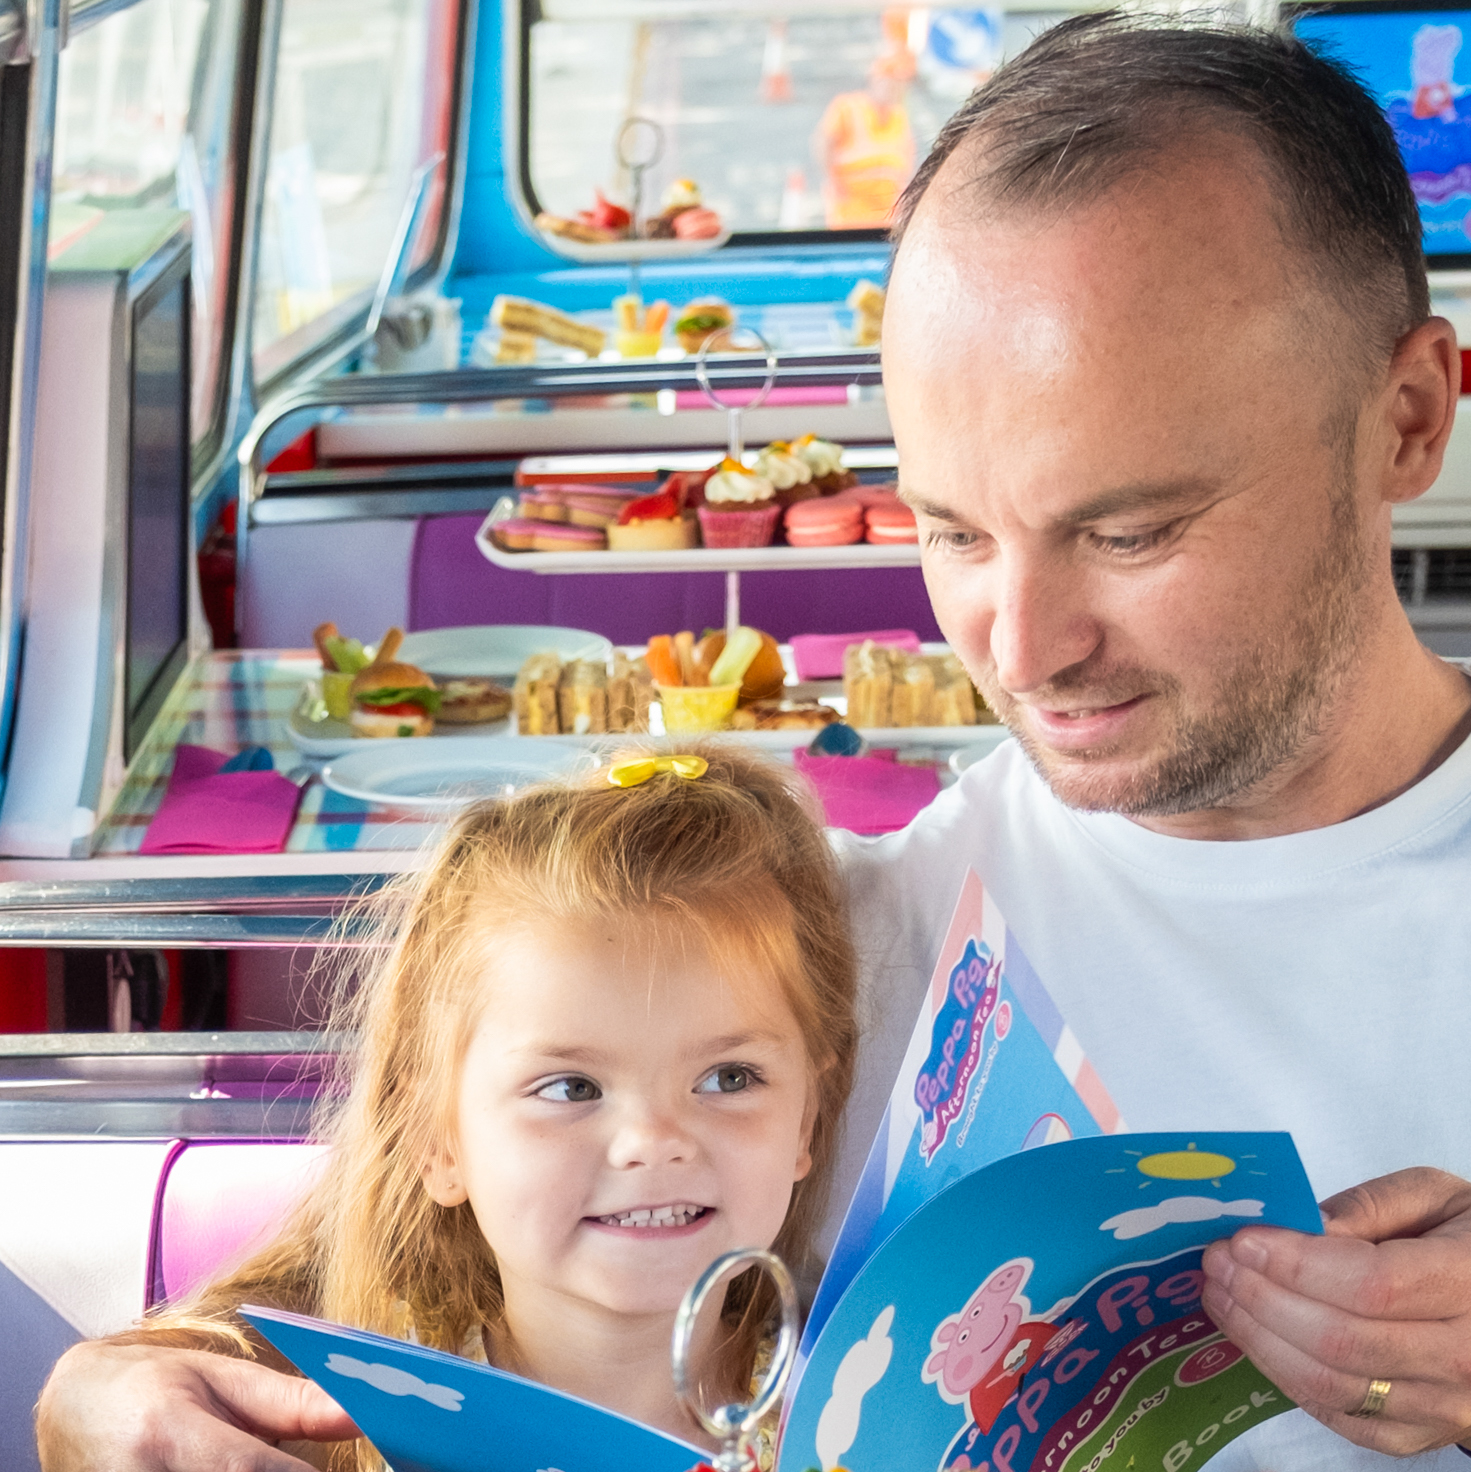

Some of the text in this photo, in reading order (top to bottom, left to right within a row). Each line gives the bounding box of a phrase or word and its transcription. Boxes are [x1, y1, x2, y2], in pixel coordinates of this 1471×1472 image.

[916, 1018, 966, 1111] Peppa
[940, 995, 992, 1126] Afternoon Tea
[1096, 1269, 1207, 1334] Pig
[1127, 1321, 1206, 1358] Tea
